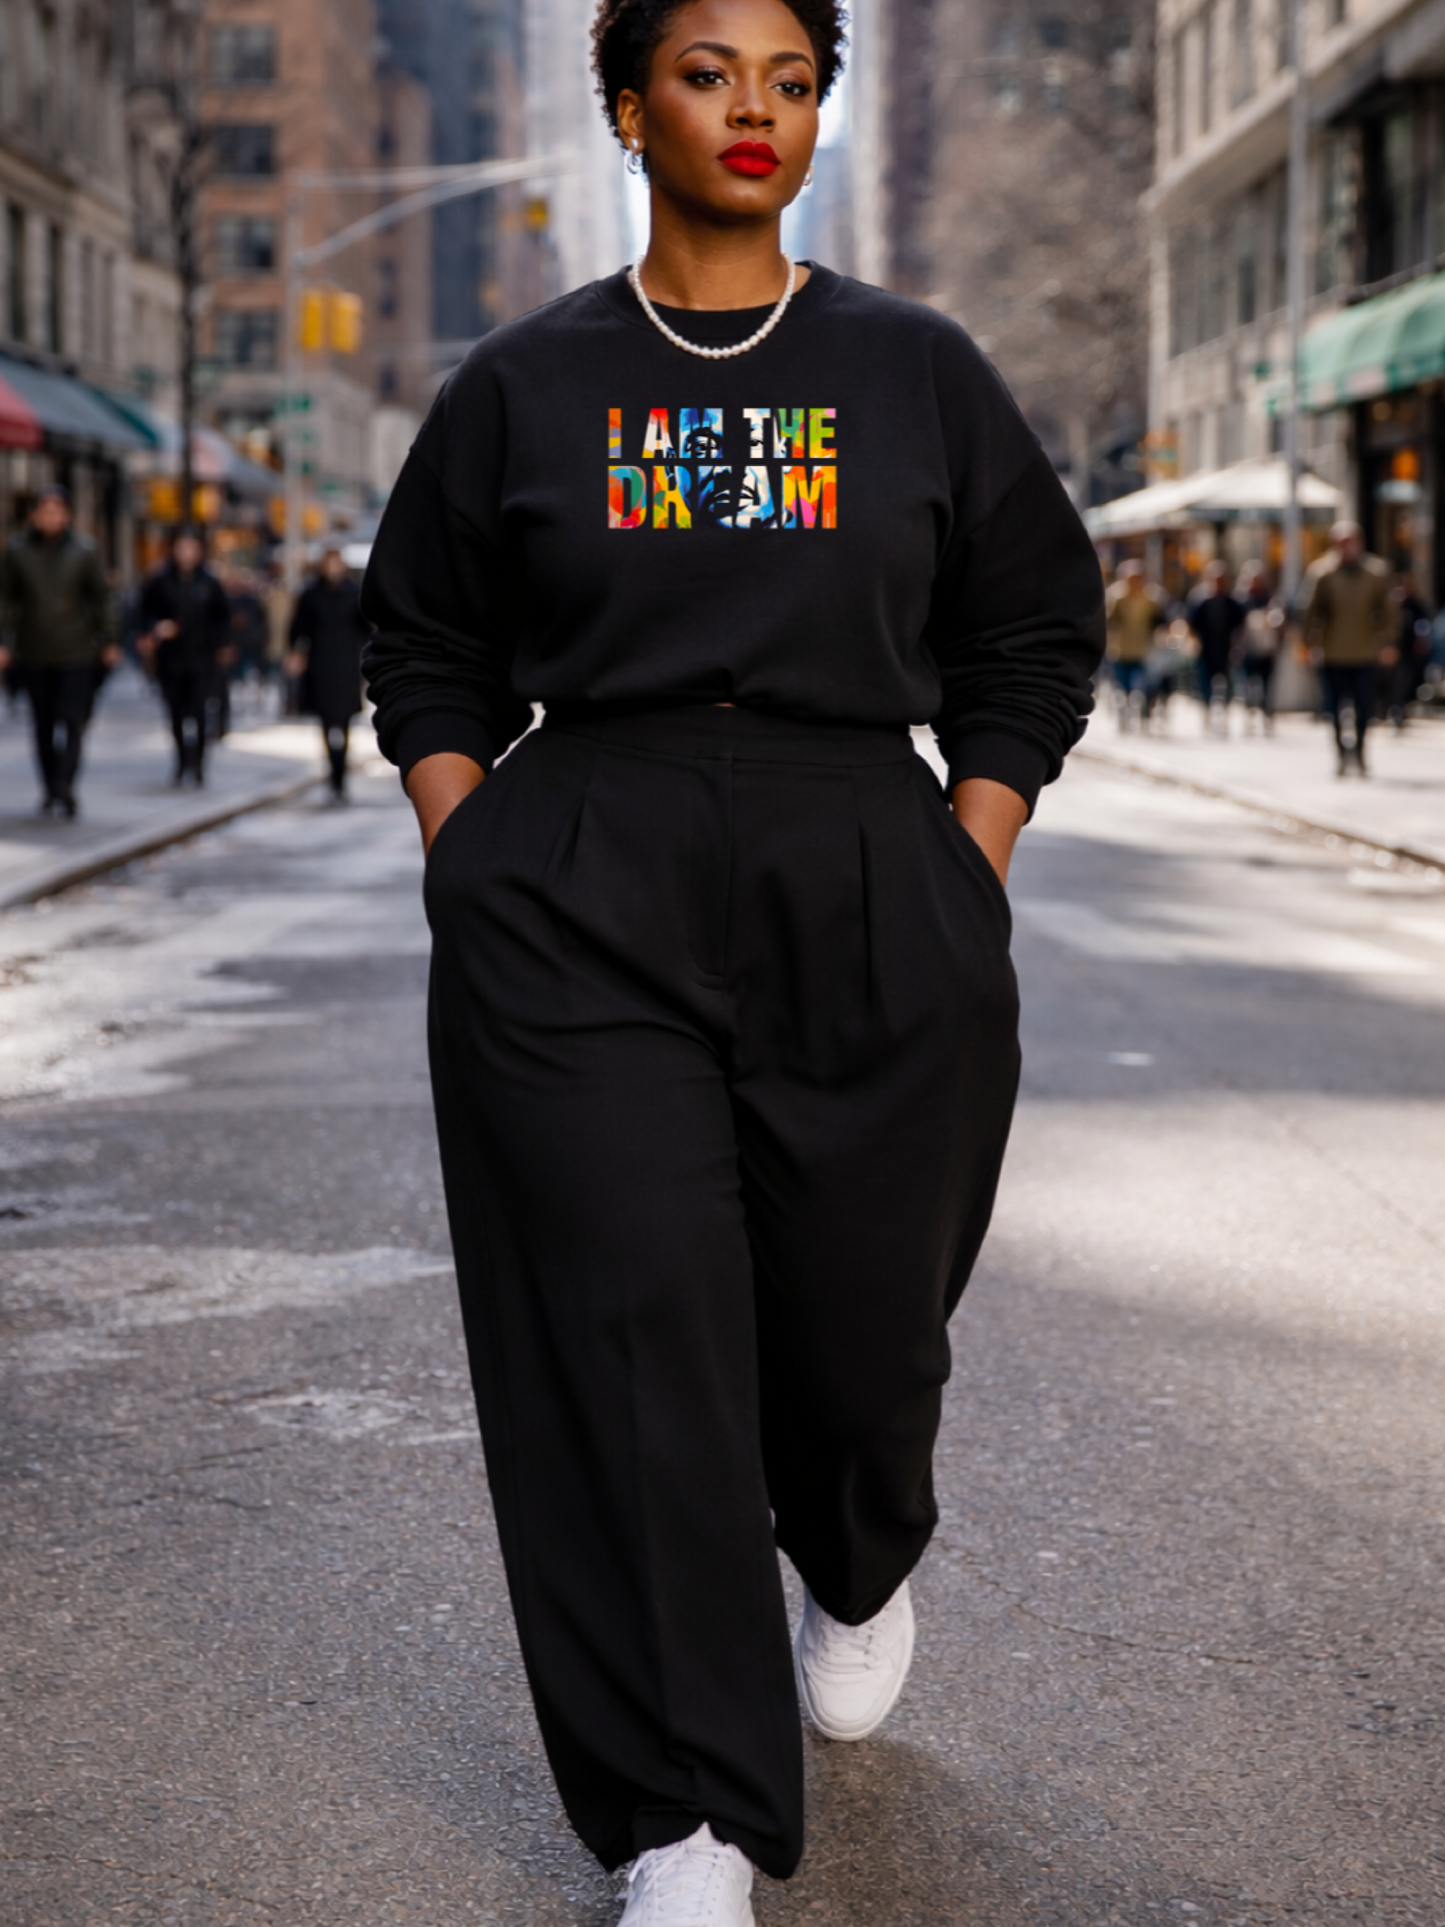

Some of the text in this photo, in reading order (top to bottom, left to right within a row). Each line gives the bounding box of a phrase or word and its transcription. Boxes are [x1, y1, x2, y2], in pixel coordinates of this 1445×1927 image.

[608, 408, 838, 459] I AM THE
[608, 465, 838, 529] DREAM
